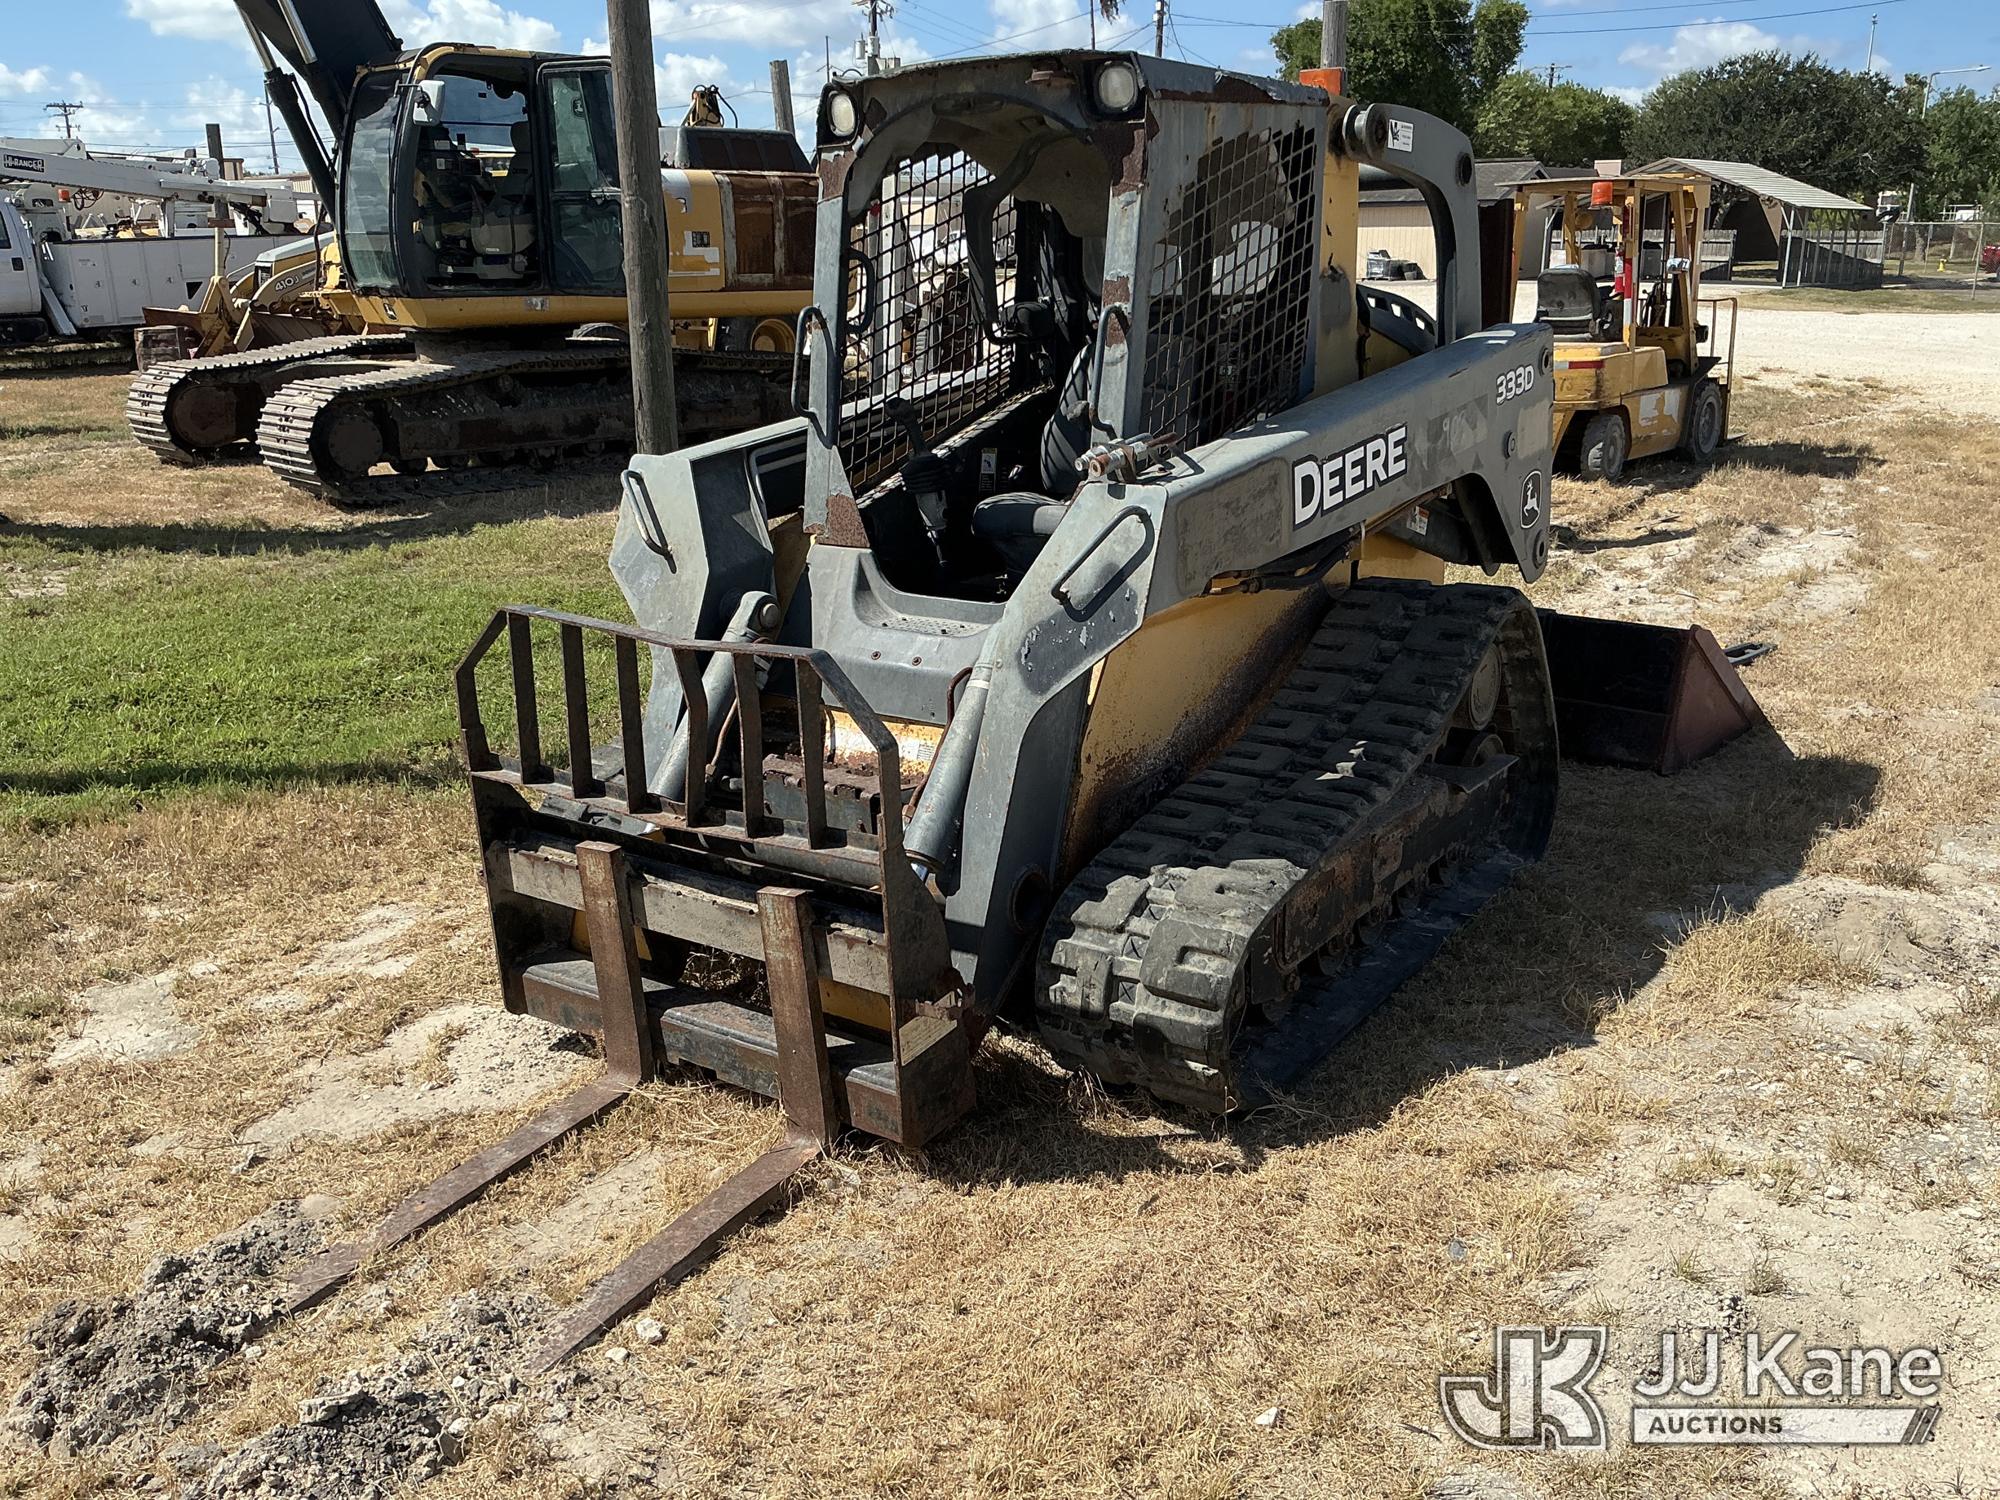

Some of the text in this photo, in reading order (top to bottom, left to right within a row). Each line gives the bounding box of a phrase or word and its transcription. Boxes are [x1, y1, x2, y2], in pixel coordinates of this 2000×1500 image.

[275, 276, 299, 291] 410J
[1496, 365, 1534, 404] 333D
[1294, 426, 1407, 525] DEERE
